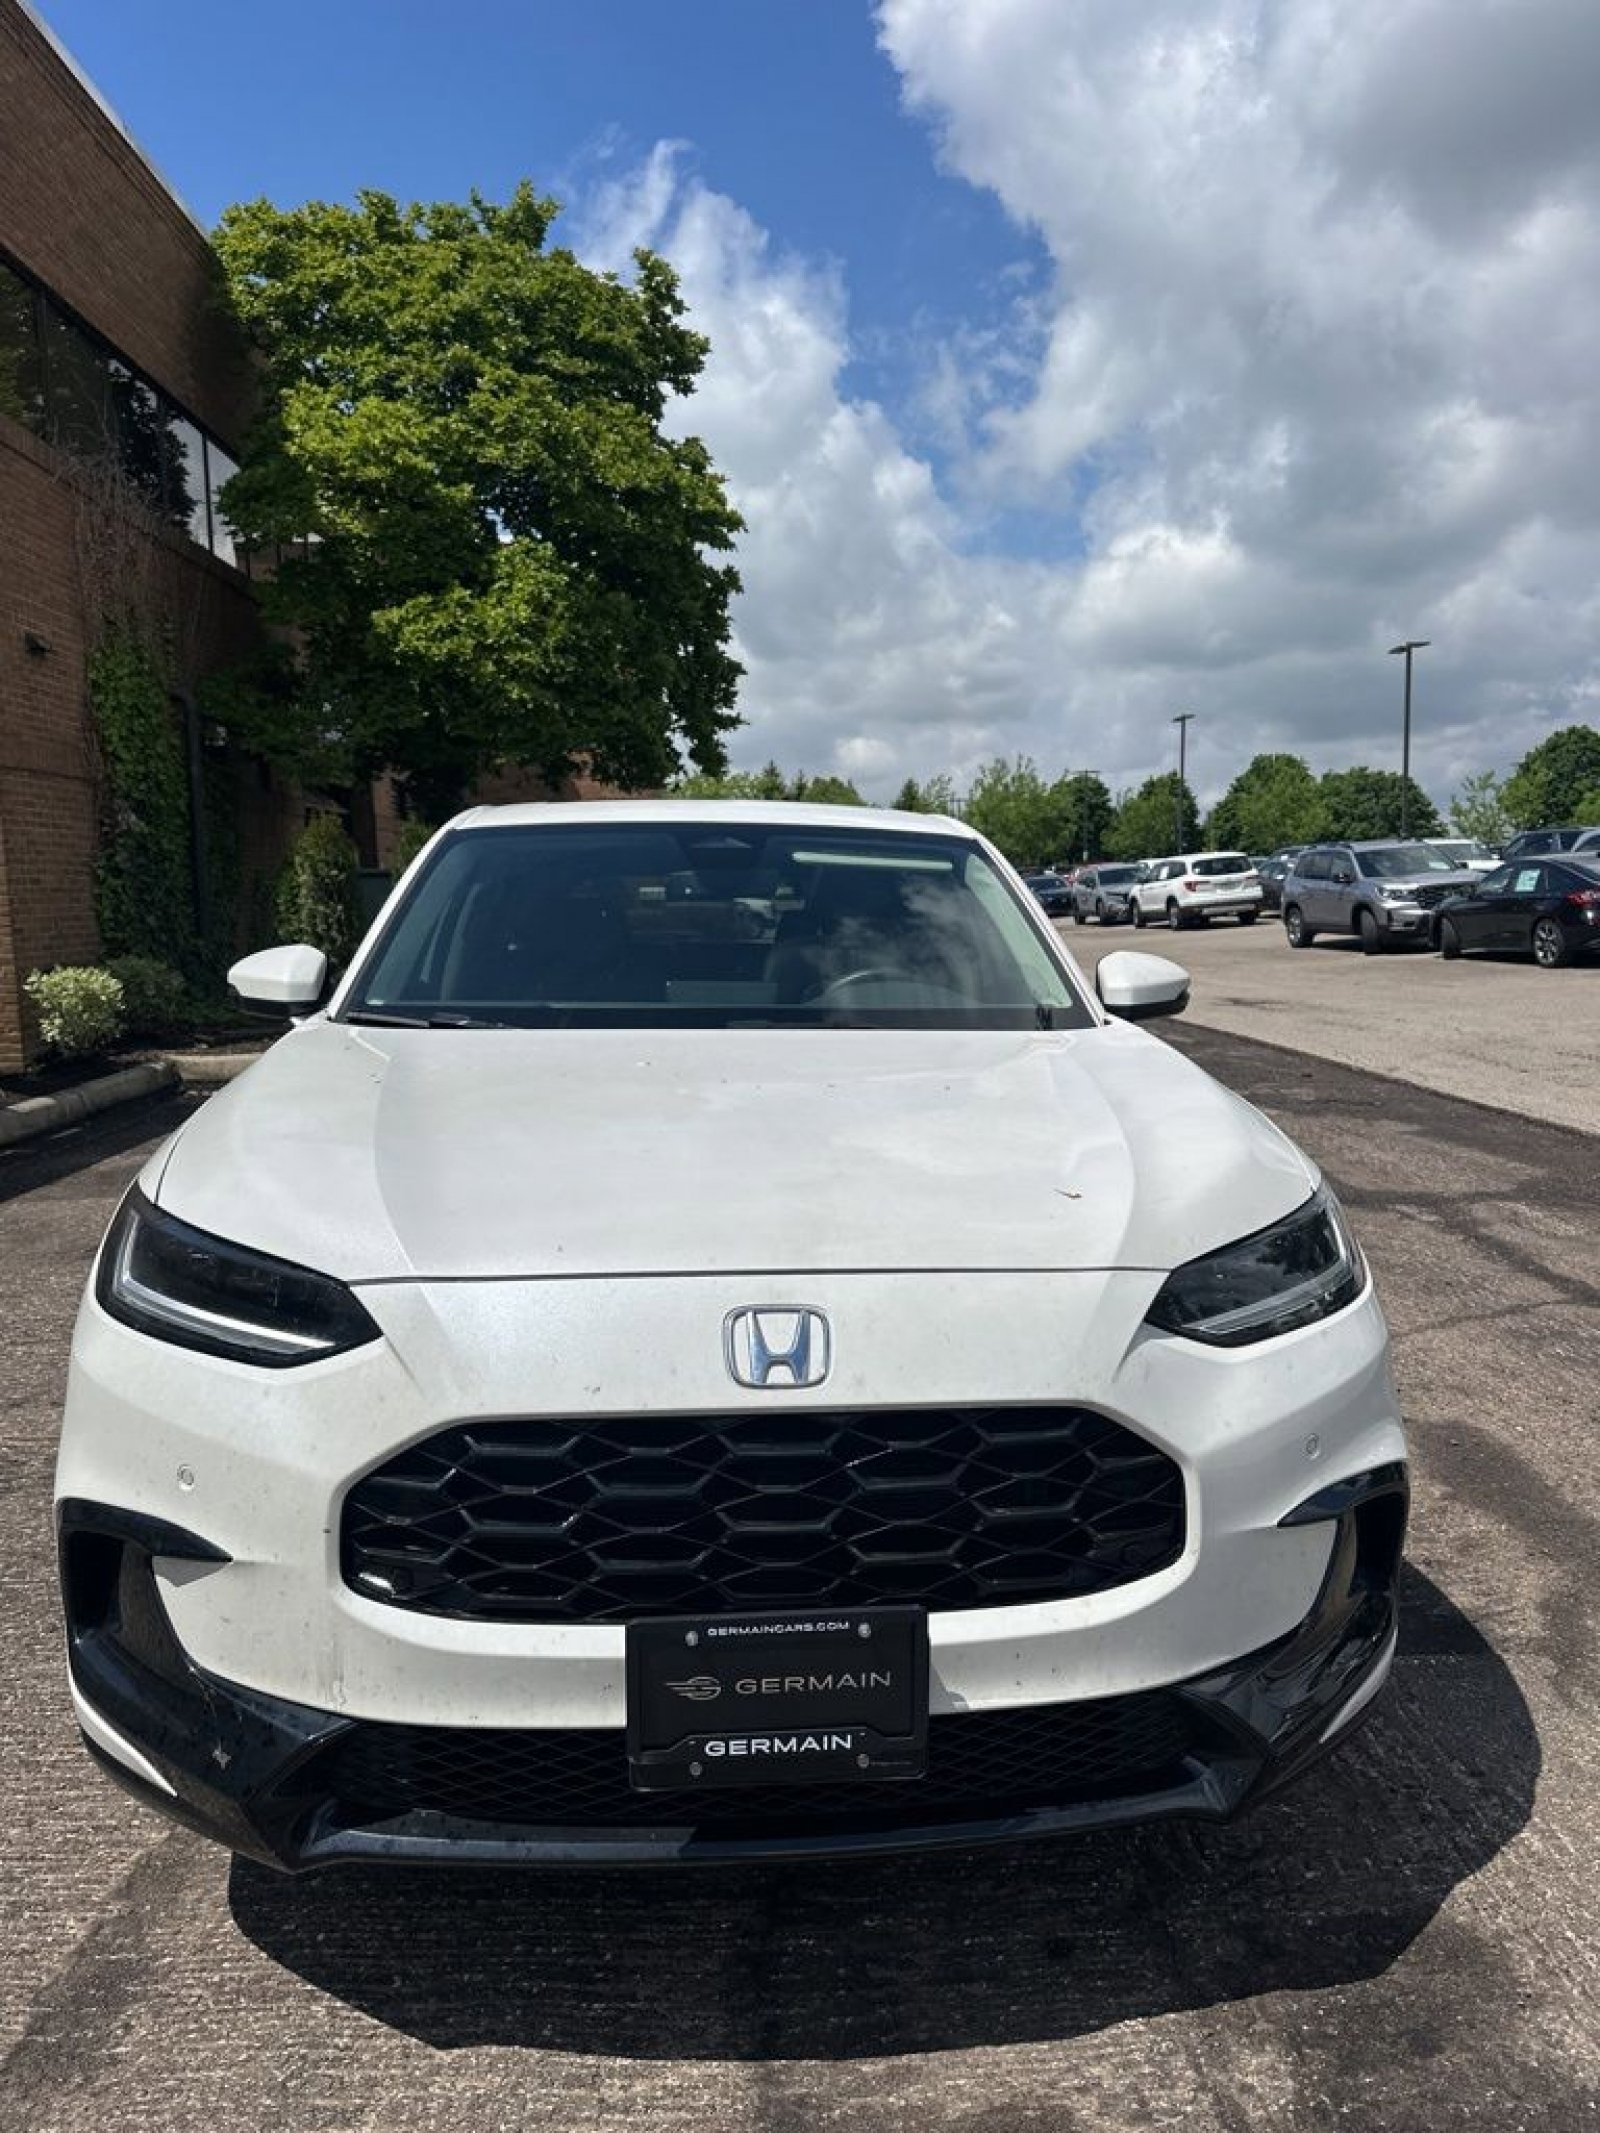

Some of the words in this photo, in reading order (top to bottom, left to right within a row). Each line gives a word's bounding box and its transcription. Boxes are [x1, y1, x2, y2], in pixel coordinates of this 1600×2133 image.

[708, 1621, 851, 1637] GERMAINCARS.COM
[734, 1671, 891, 1695] GERMAIN
[704, 1734, 853, 1757] GERMAIN
